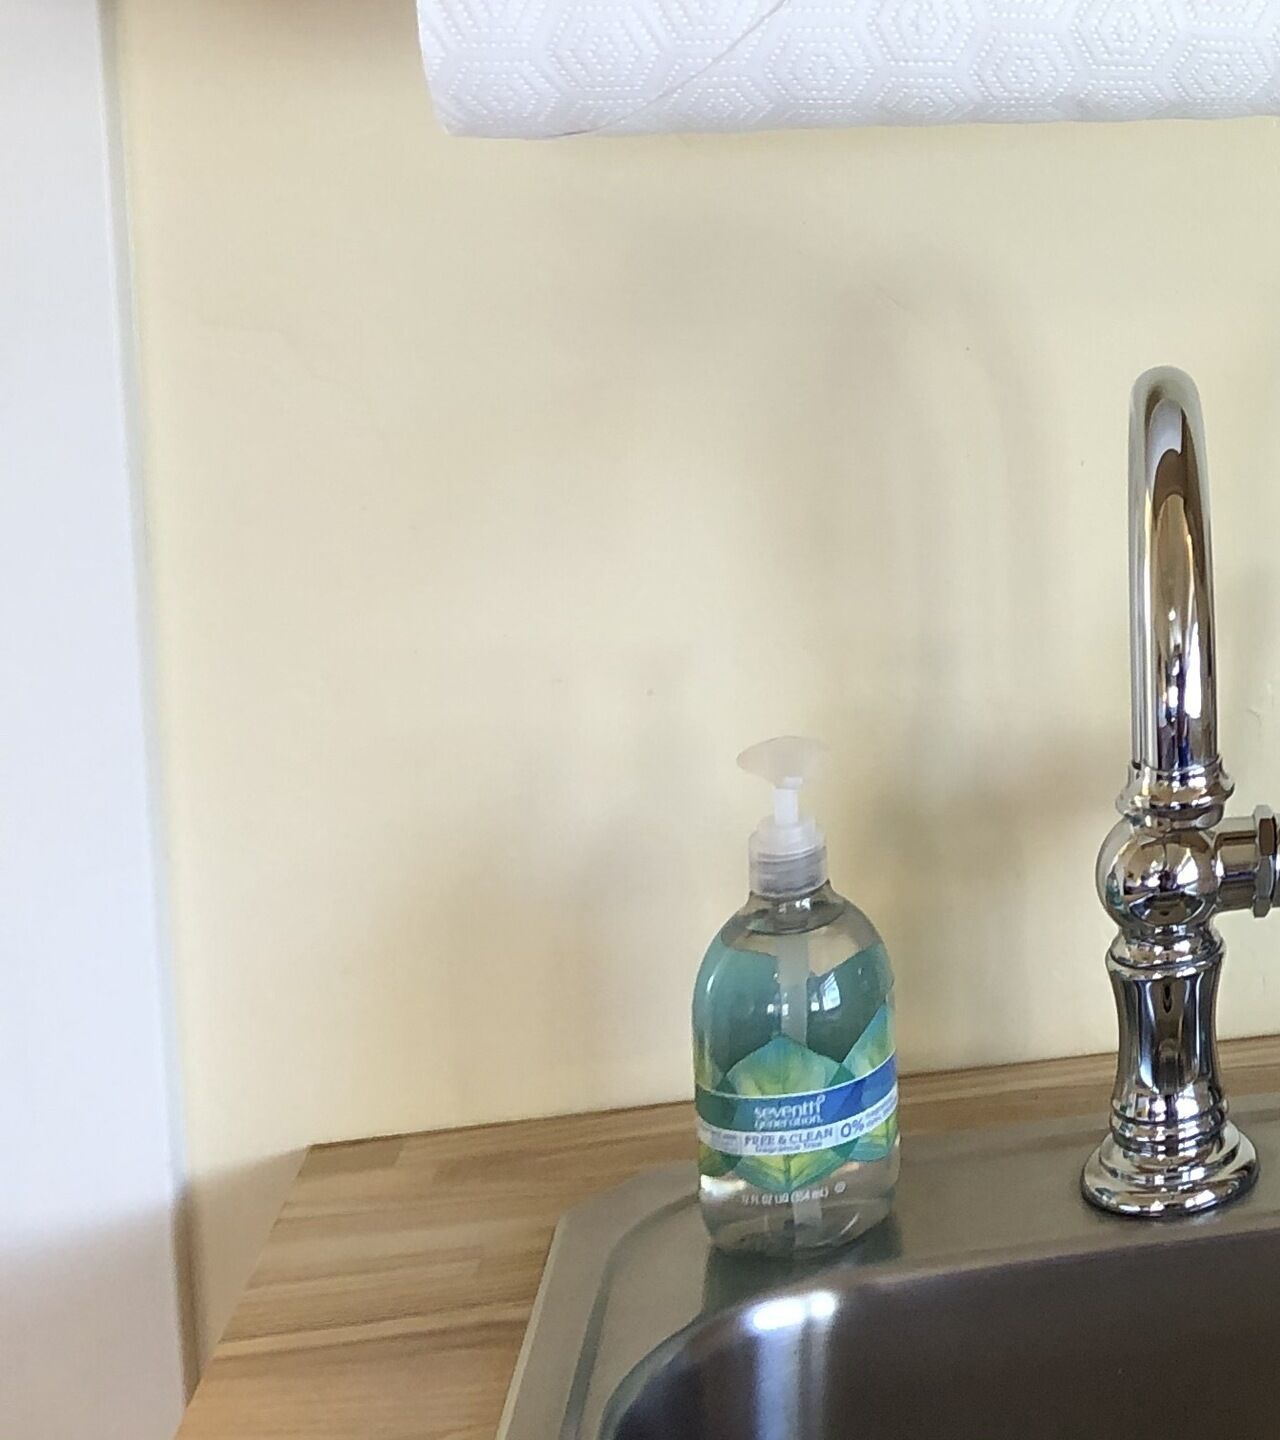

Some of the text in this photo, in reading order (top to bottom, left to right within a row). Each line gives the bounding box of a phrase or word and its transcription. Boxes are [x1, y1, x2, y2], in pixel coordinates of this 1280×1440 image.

[753, 1094, 827, 1119] seventh
[789, 1126, 833, 1144] CLEAN
[840, 1117, 865, 1138] 0%
